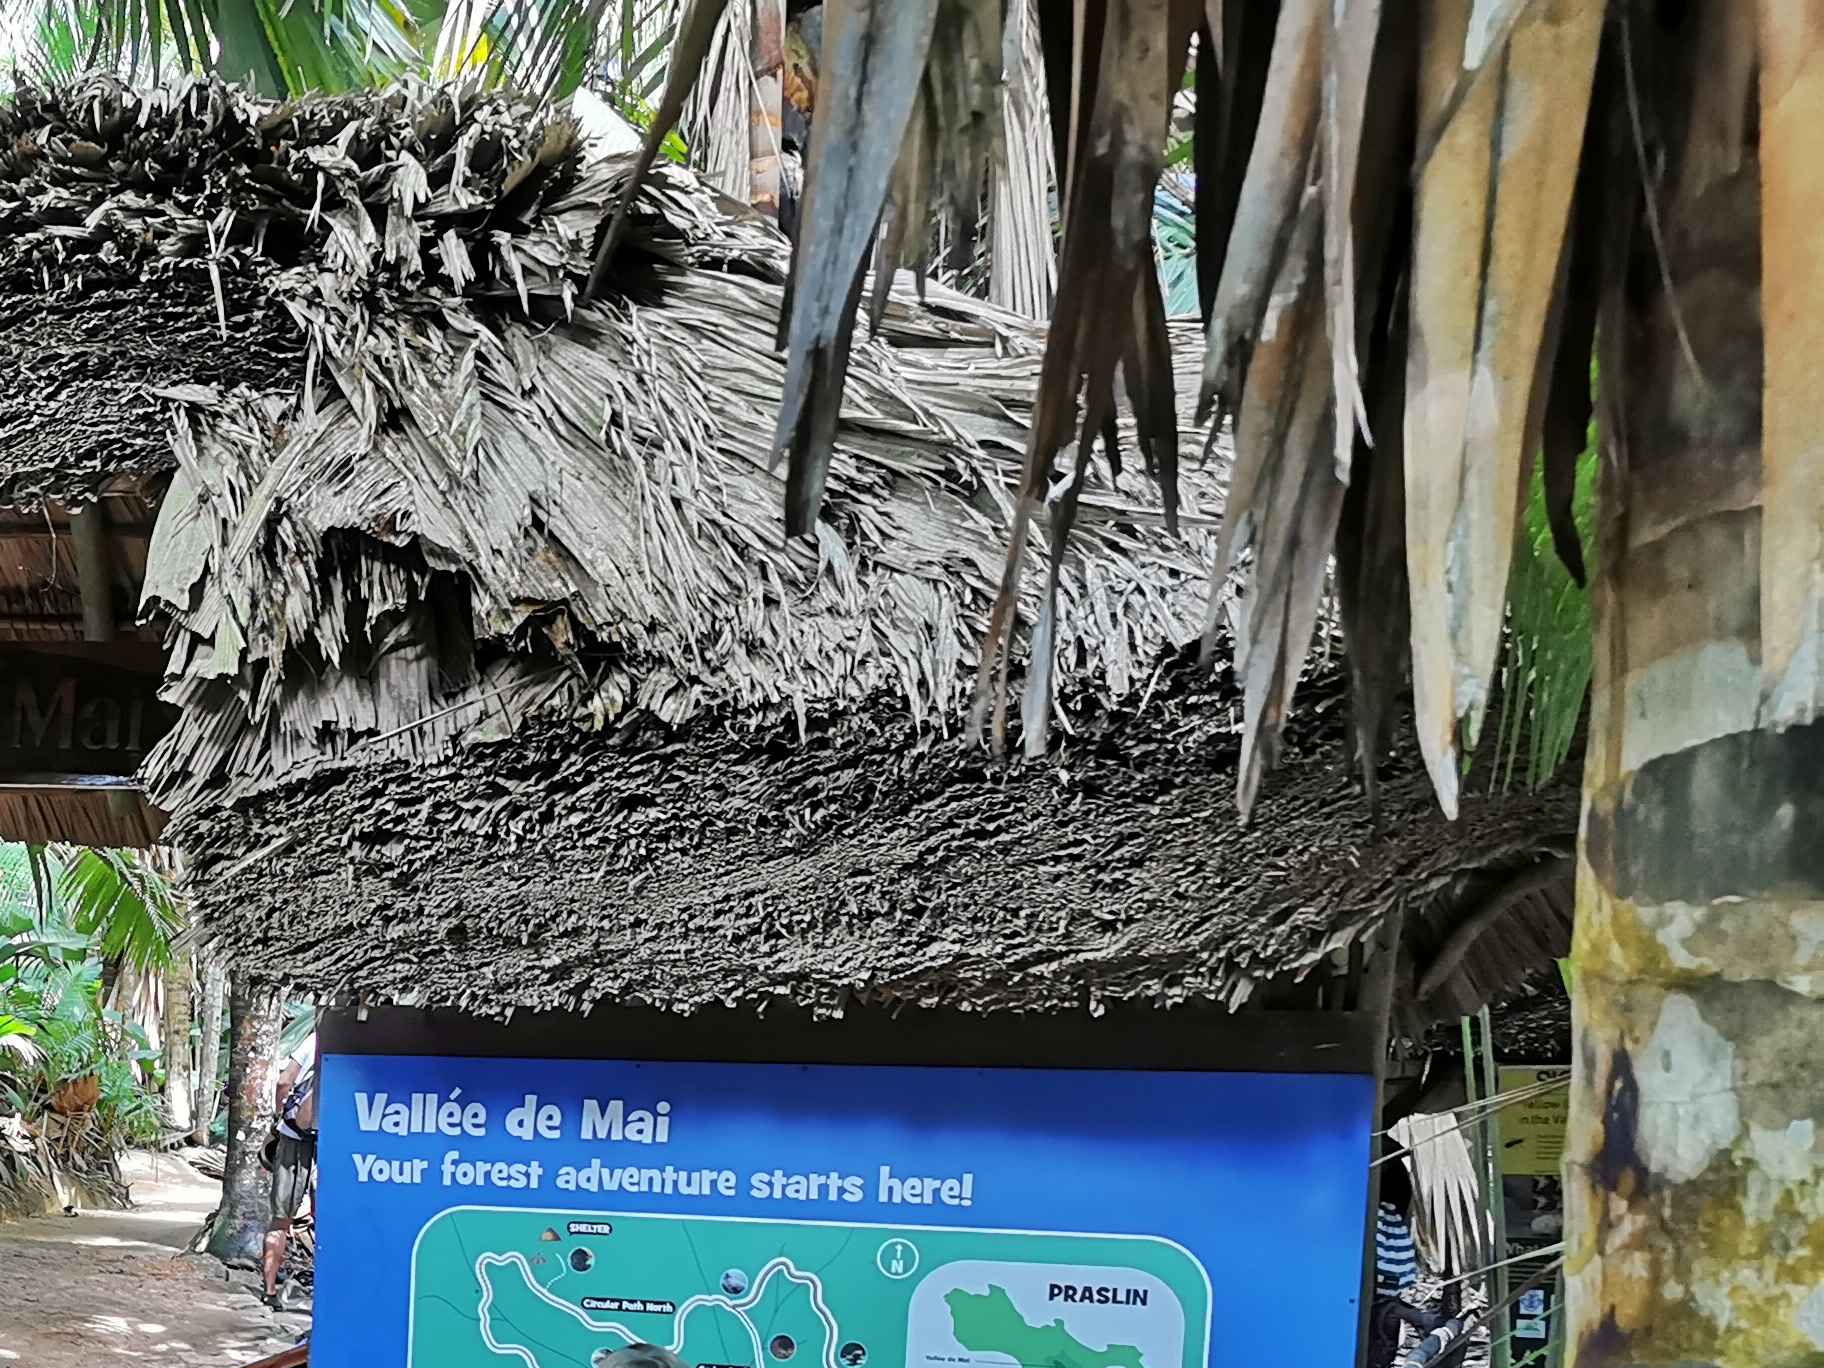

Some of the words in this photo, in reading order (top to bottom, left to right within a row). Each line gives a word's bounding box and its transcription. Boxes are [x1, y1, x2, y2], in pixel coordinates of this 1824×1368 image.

[12, 677, 143, 751] Mai
[354, 1086, 487, 1137] Vallée
[505, 1094, 562, 1140] de
[580, 1099, 672, 1144] Mai
[352, 1153, 428, 1184] Your
[440, 1150, 543, 1189] forest
[555, 1158, 737, 1196] adventure
[749, 1169, 865, 1203] starts
[878, 1165, 973, 1207] here!
[569, 1223, 611, 1235] SHELTER
[583, 1299, 619, 1310] Circular
[622, 1301, 644, 1312] Path
[646, 1302, 674, 1313] North
[1048, 1283, 1149, 1307] PRASLIN
